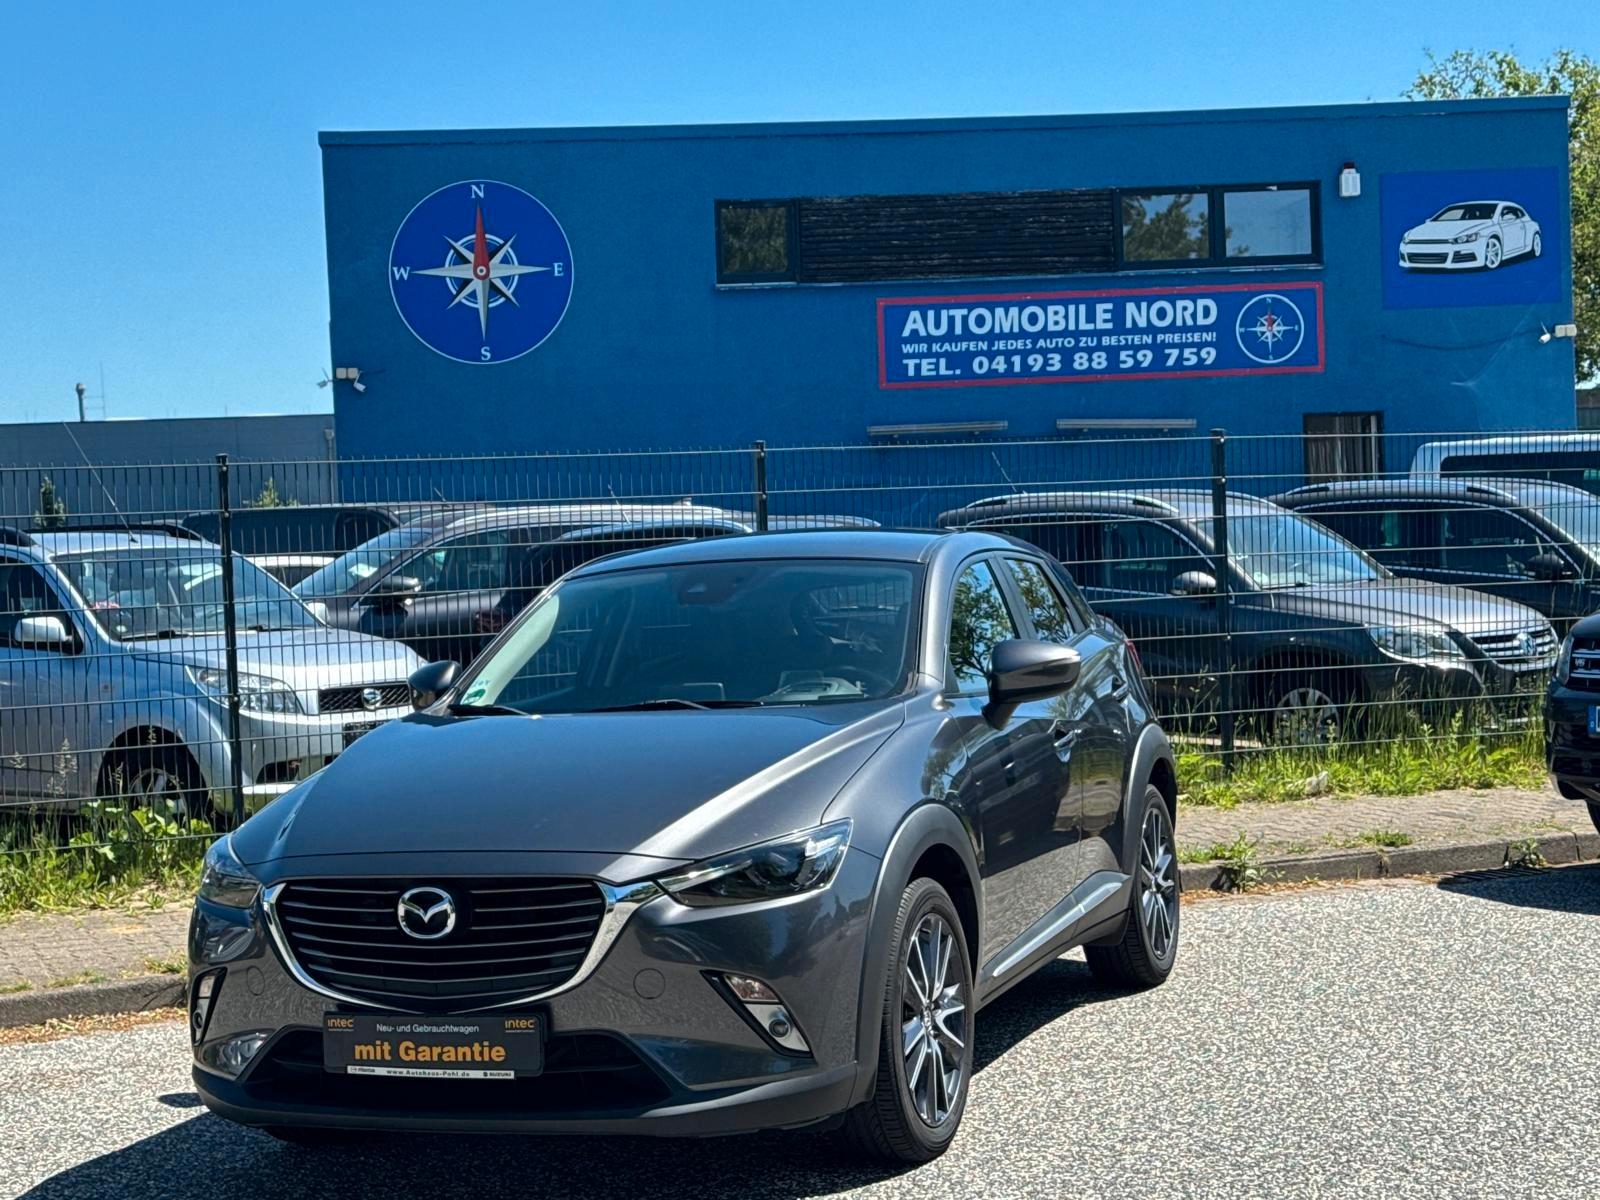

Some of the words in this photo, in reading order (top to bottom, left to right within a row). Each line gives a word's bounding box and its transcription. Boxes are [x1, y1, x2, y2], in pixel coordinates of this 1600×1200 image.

[470, 184, 485, 199] N
[392, 266, 410, 280] W
[553, 262, 564, 277] E
[901, 303, 1113, 337] AUTOMOBILE
[1125, 298, 1218, 328] NORD
[901, 343, 928, 353] WIR
[932, 341, 988, 352] KAUFEN
[991, 339, 1032, 350] JEDES
[1036, 337, 1075, 349] AUTO
[1079, 336, 1097, 347] ZU
[1102, 334, 1152, 346] BESTEN
[1157, 332, 1217, 344] PREISEN!
[480, 346, 491, 361] S
[902, 357, 961, 377] TEL.
[972, 353, 1062, 374] 04193
[1073, 351, 1107, 370] 88
[1119, 349, 1153, 368] 59
[1164, 347, 1217, 366] 759
[376, 1024, 395, 1032] Neu-
[396, 1024, 411, 1032] und
[412, 1024, 479, 1035] Gebrauchtwagen
[505, 1018, 535, 1028] intec
[354, 1040, 392, 1060] mit
[398, 1040, 506, 1062] Garantie
